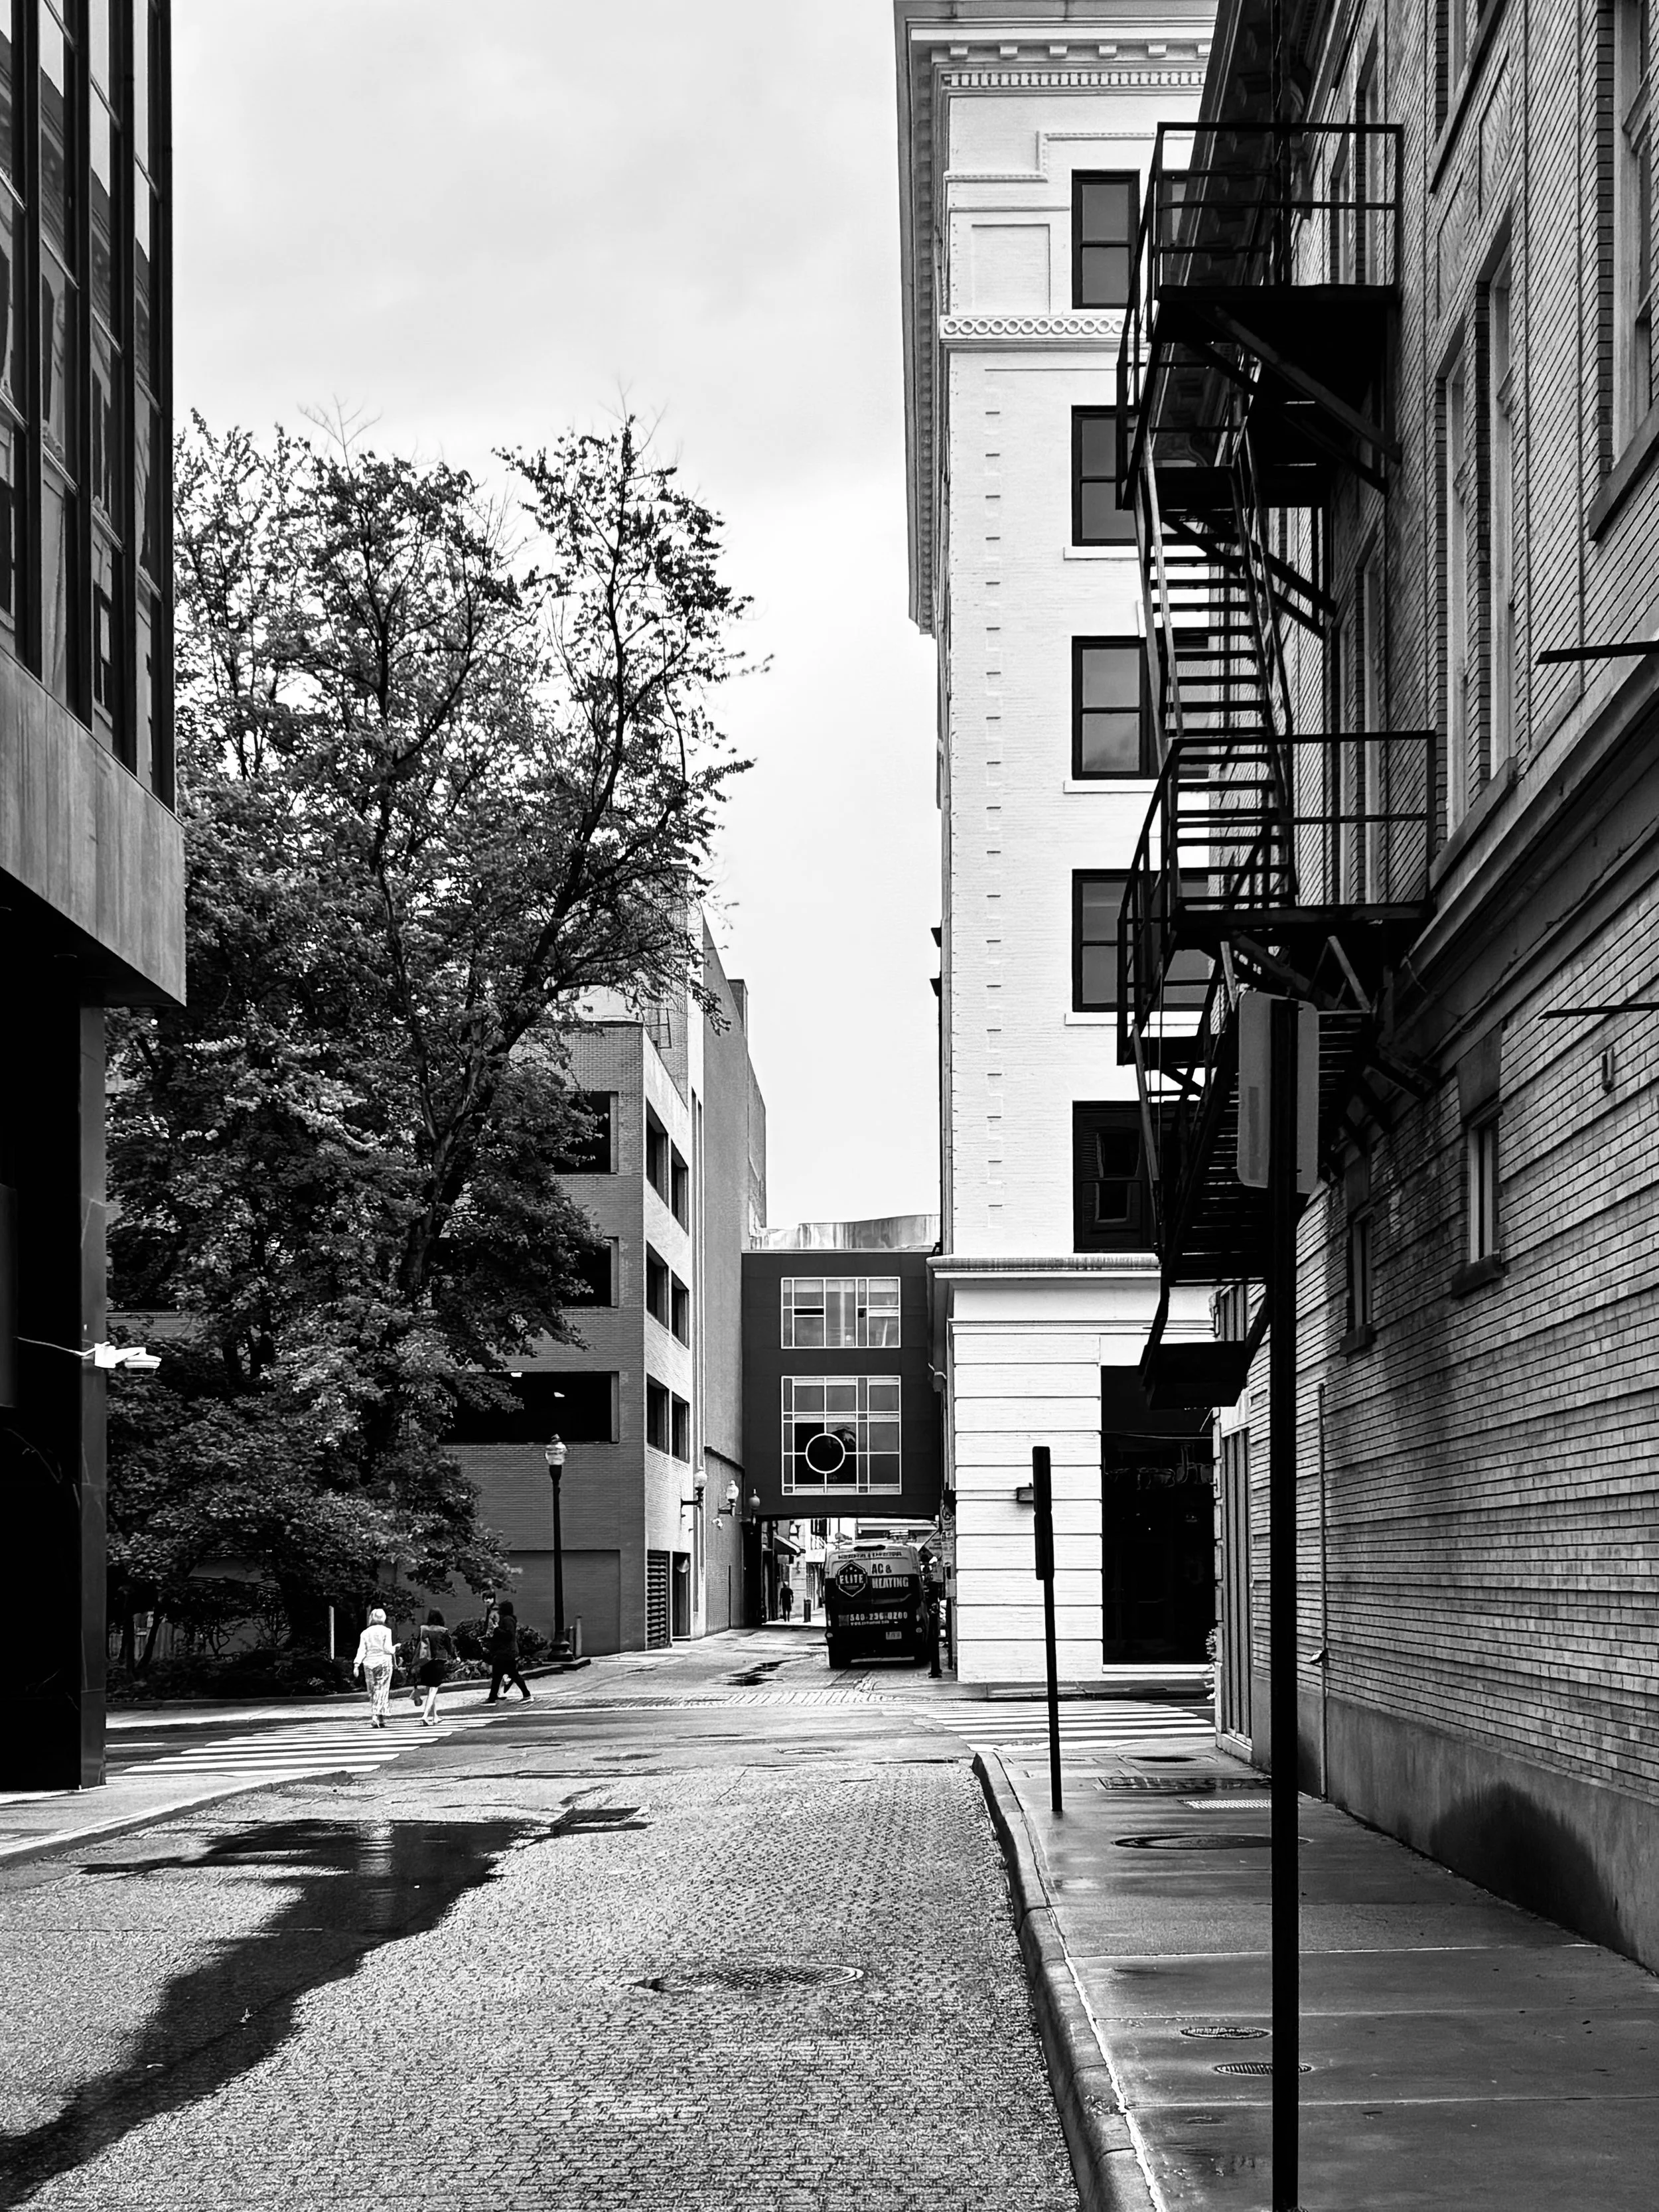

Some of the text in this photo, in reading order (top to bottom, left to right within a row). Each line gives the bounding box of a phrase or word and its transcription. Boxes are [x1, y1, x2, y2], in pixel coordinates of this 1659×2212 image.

[871, 1563, 892, 1575] AC &
[839, 1574, 864, 1584] ELITE
[872, 1576, 909, 1589] HEATING
